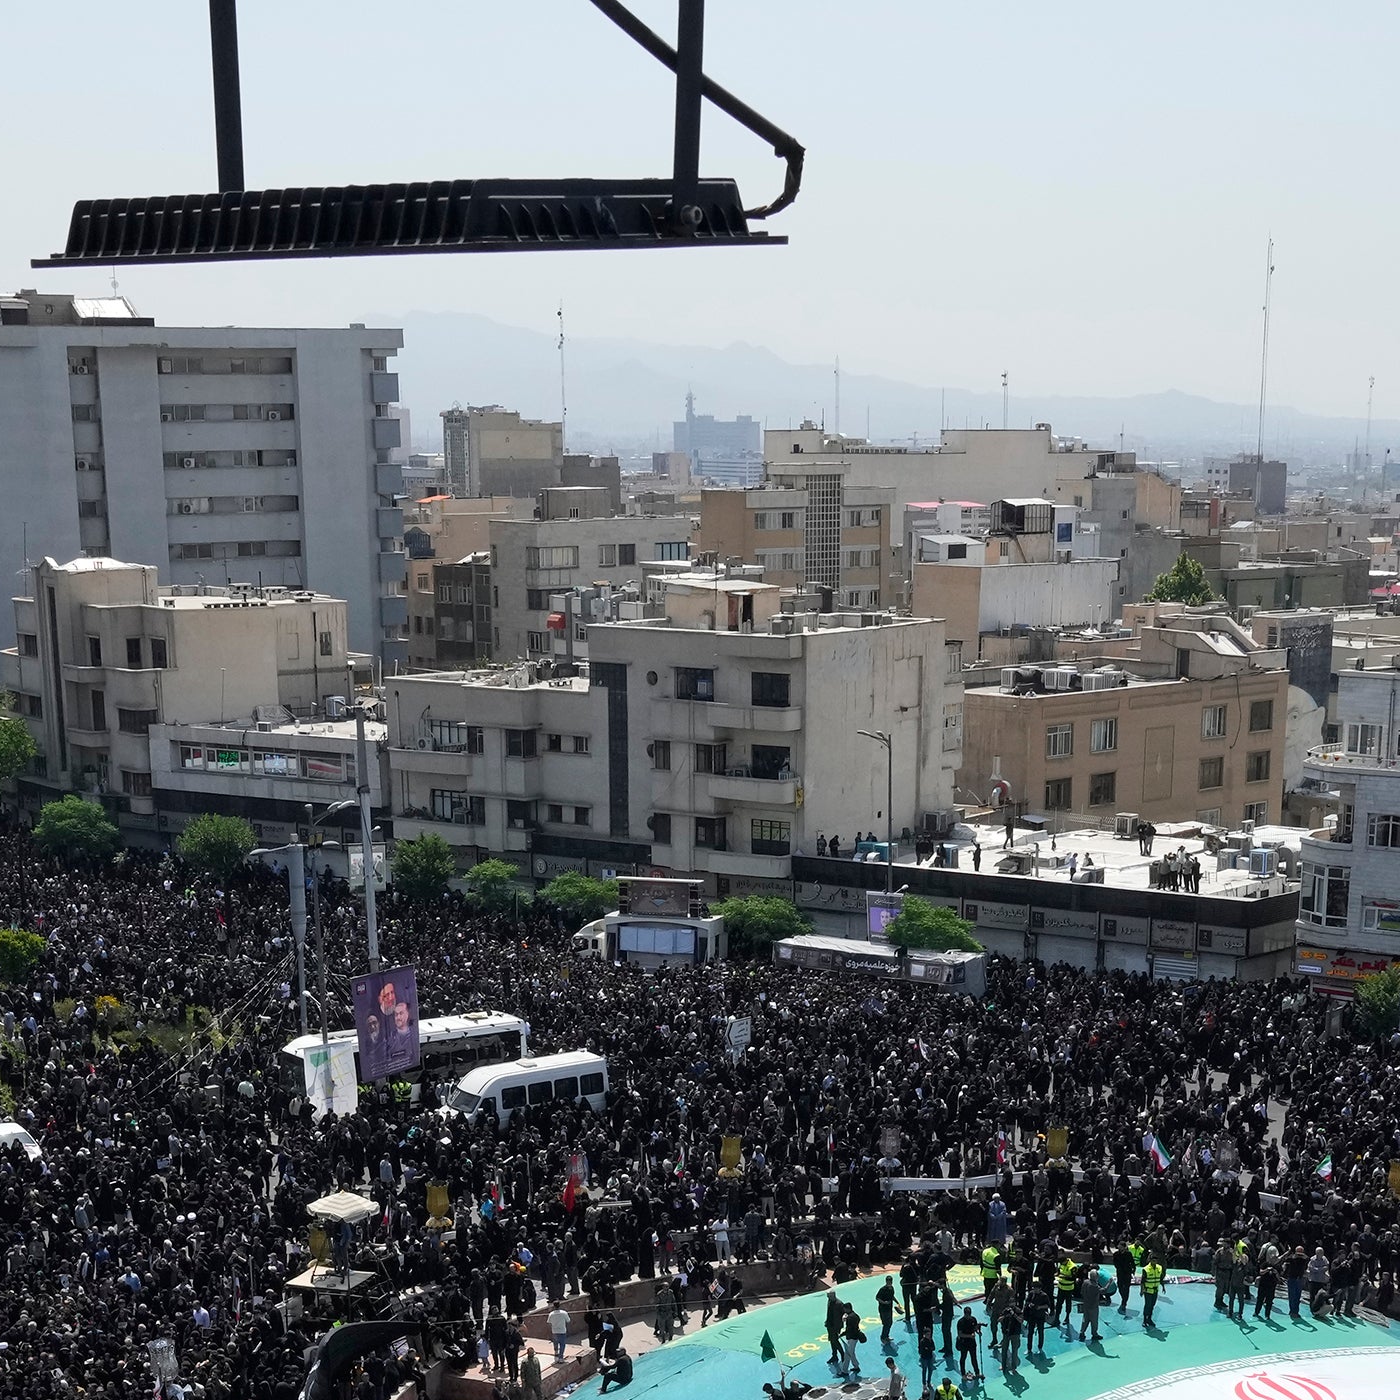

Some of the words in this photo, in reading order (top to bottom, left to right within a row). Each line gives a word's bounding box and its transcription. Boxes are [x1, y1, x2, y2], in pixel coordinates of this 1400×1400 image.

[845, 959, 864, 970] مروی
[863, 958, 886, 973] علمیه
[884, 962, 901, 974] حوزه
